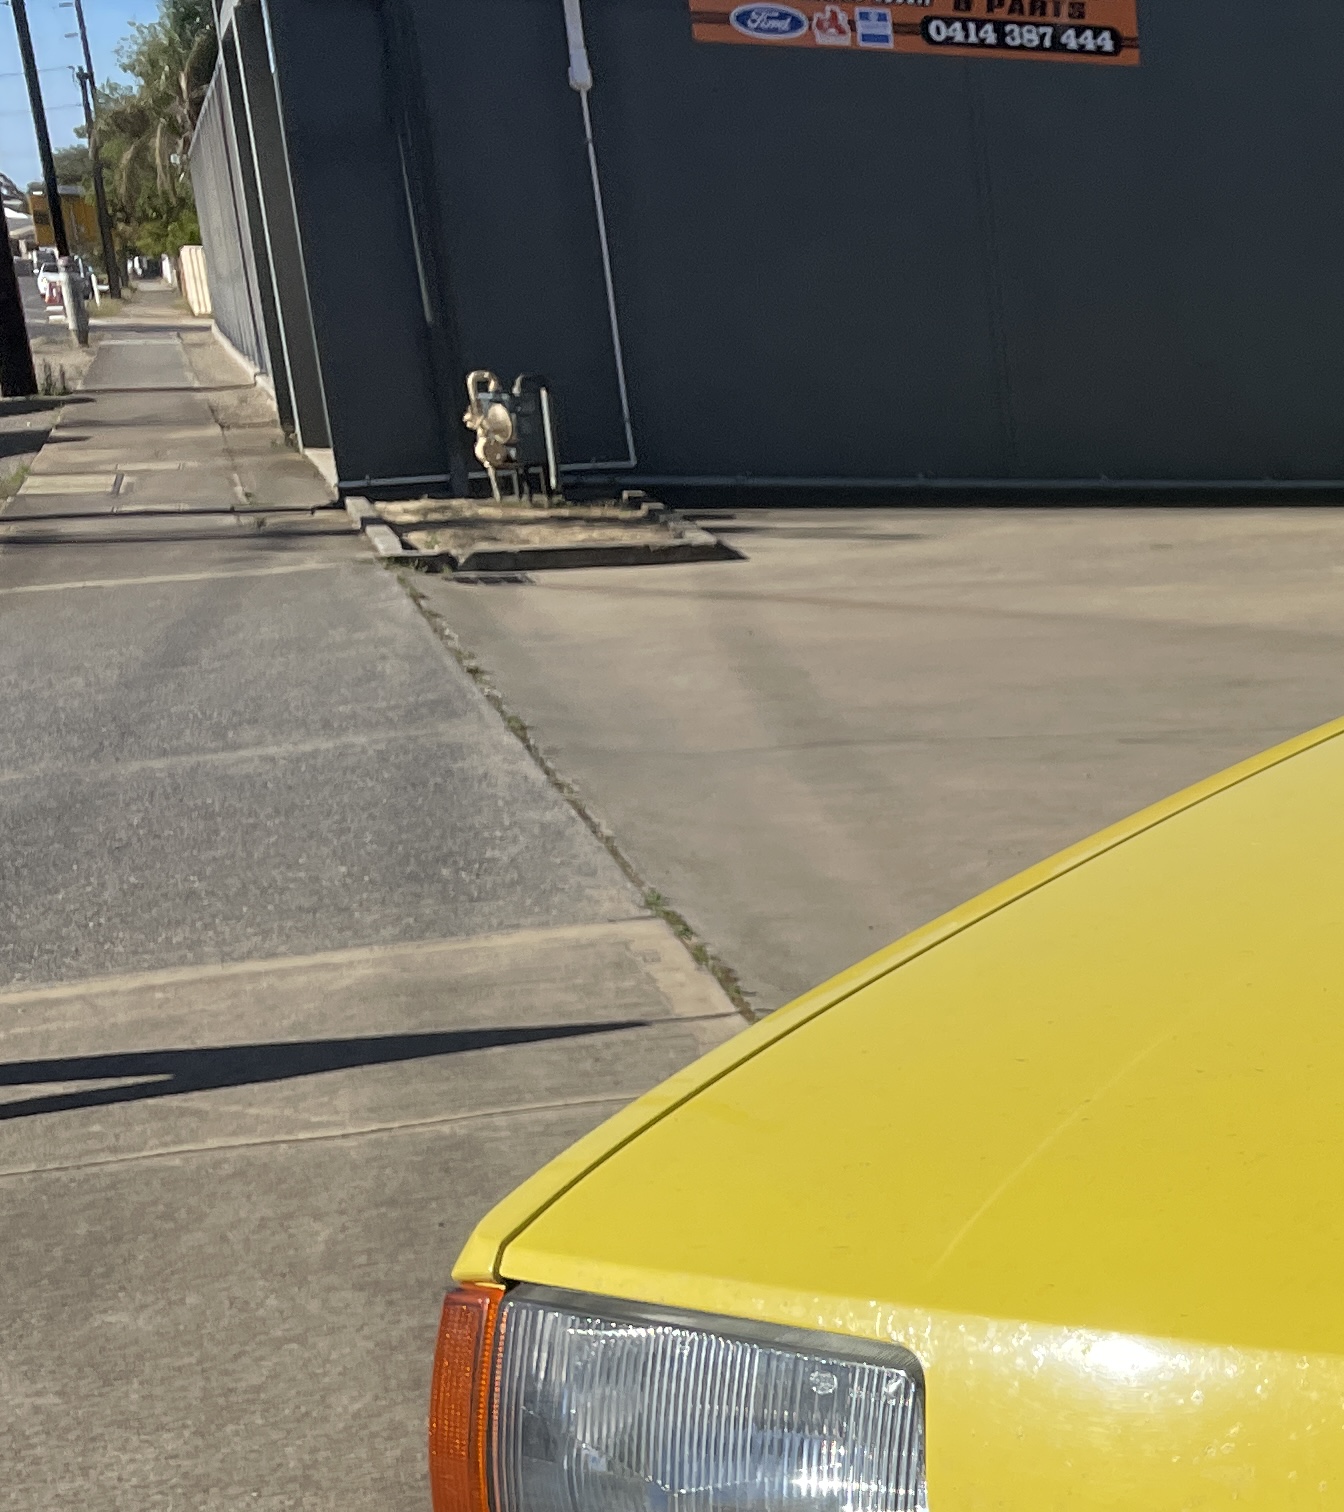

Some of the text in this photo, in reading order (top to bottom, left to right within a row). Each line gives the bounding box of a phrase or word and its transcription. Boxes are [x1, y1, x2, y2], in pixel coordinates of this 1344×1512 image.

[927, 18, 1116, 53] 0414 387 444
